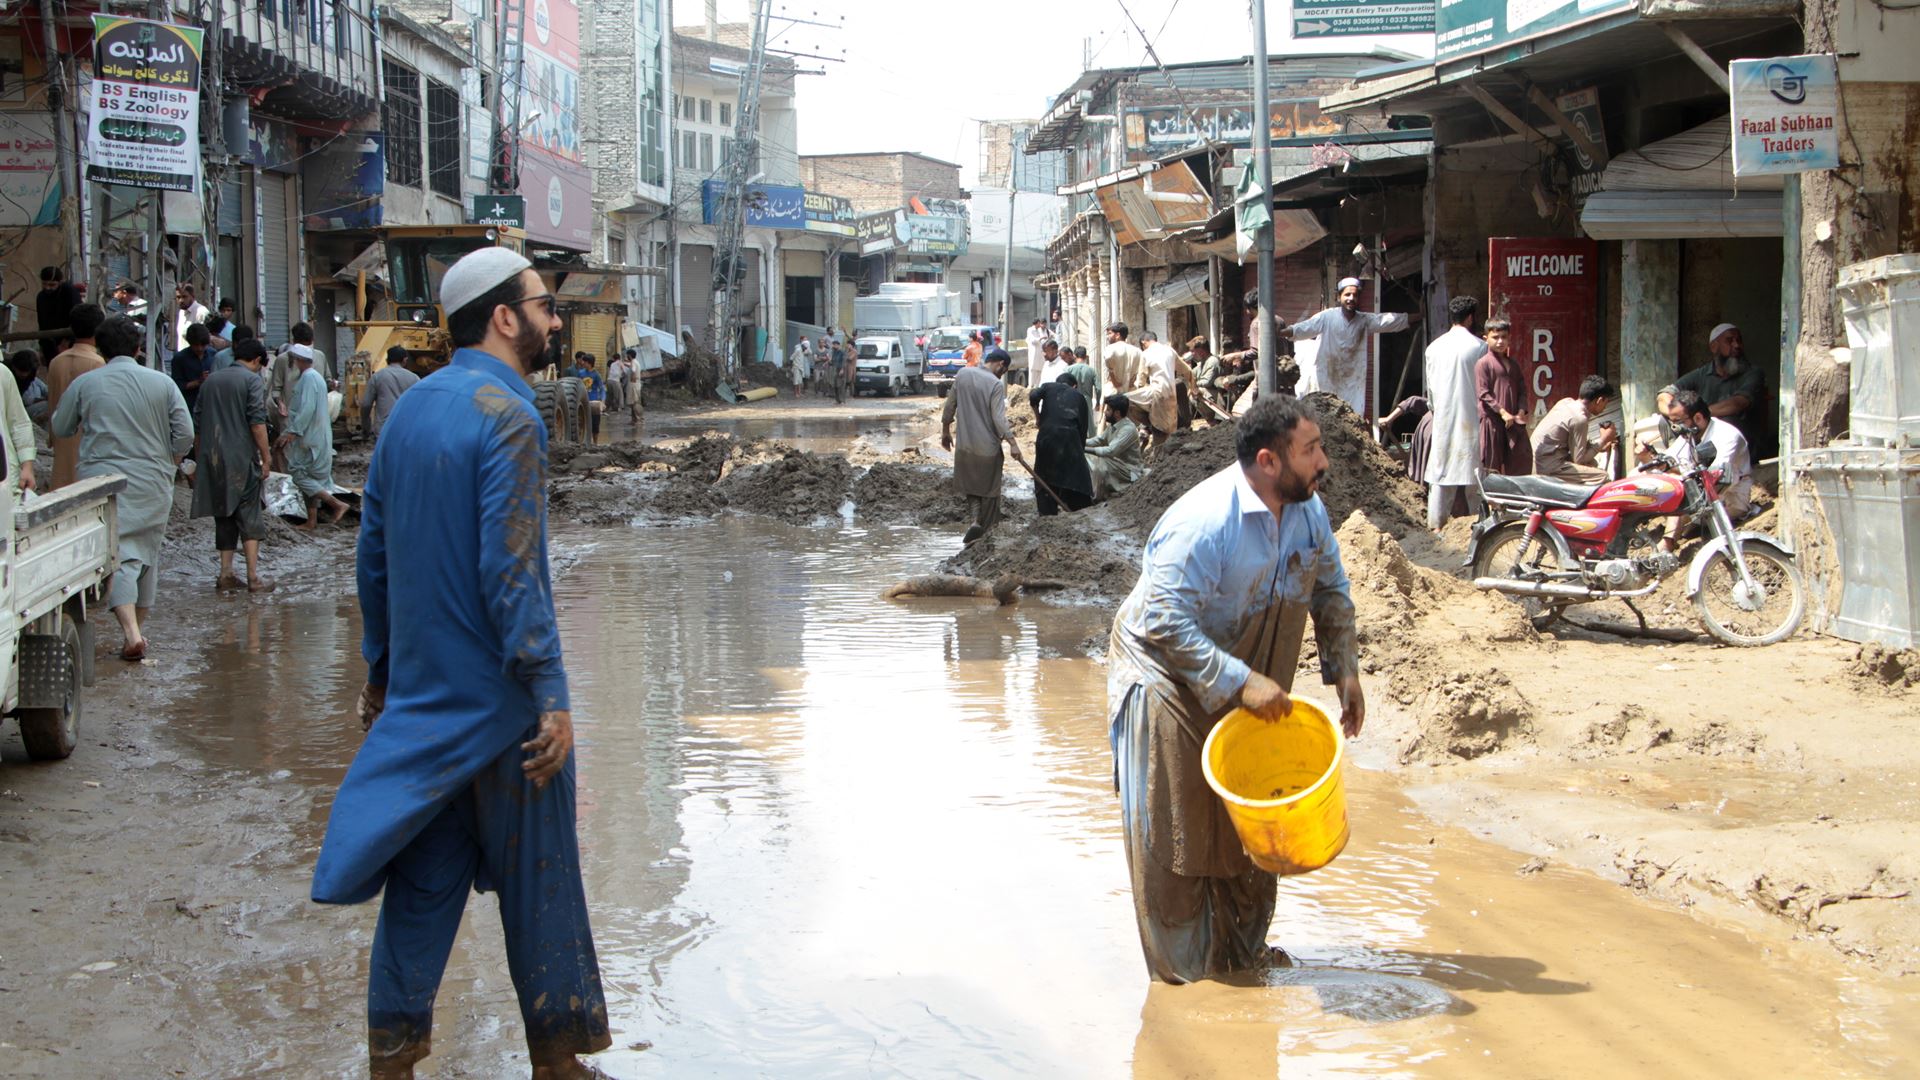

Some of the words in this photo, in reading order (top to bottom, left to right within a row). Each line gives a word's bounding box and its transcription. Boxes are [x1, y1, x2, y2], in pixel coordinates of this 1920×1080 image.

[102, 84, 123, 96] BS
[128, 87, 188, 104] English
[99, 97, 120, 110] BS
[125, 101, 190, 120] Zoology
[1741, 117, 1777, 136] Fazal
[1781, 114, 1833, 132] Subhan
[99, 140, 124, 150] Students
[126, 144, 153, 153] awaiting
[154, 146, 168, 154] their
[1762, 137, 1815, 154] Traders
[96, 150, 116, 158] results
[129, 153, 145, 162] apply
[804, 193, 832, 212] ZEENAT
[479, 217, 519, 226] alkaram
[1507, 255, 1583, 277] WELCOME
[1537, 285, 1552, 296] TO
